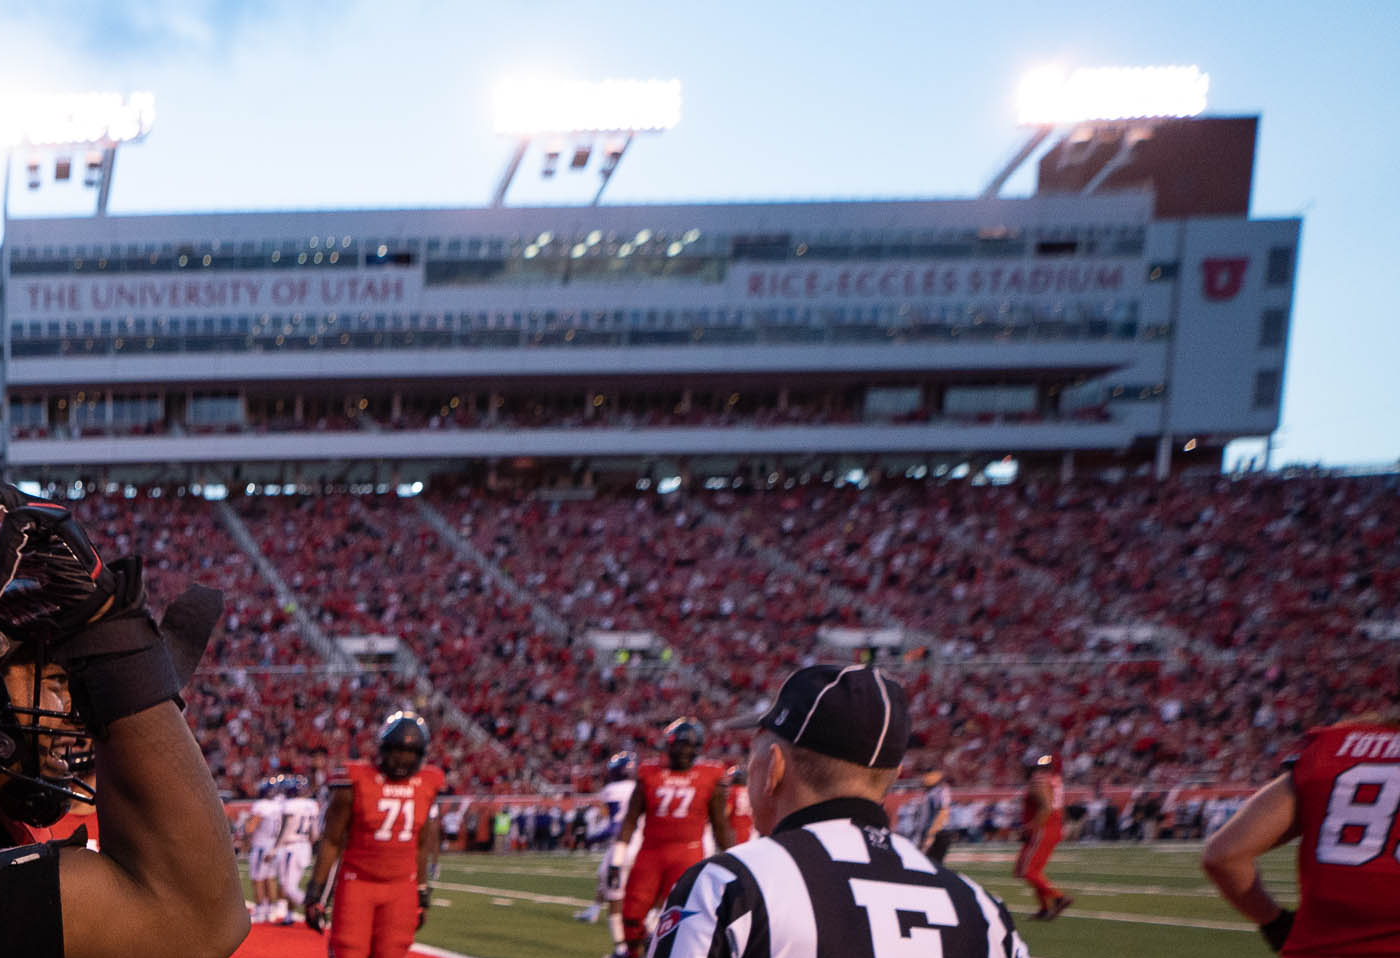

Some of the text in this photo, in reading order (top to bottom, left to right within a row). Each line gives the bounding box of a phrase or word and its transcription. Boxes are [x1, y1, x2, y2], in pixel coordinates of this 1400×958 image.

[26, 276, 404, 311] THE UNIVERSITY OF UTAH
[967, 265, 1124, 295] STADIUM
[374, 797, 415, 841] 71
[655, 785, 696, 819] 77
[1315, 761, 1400, 867] 8
